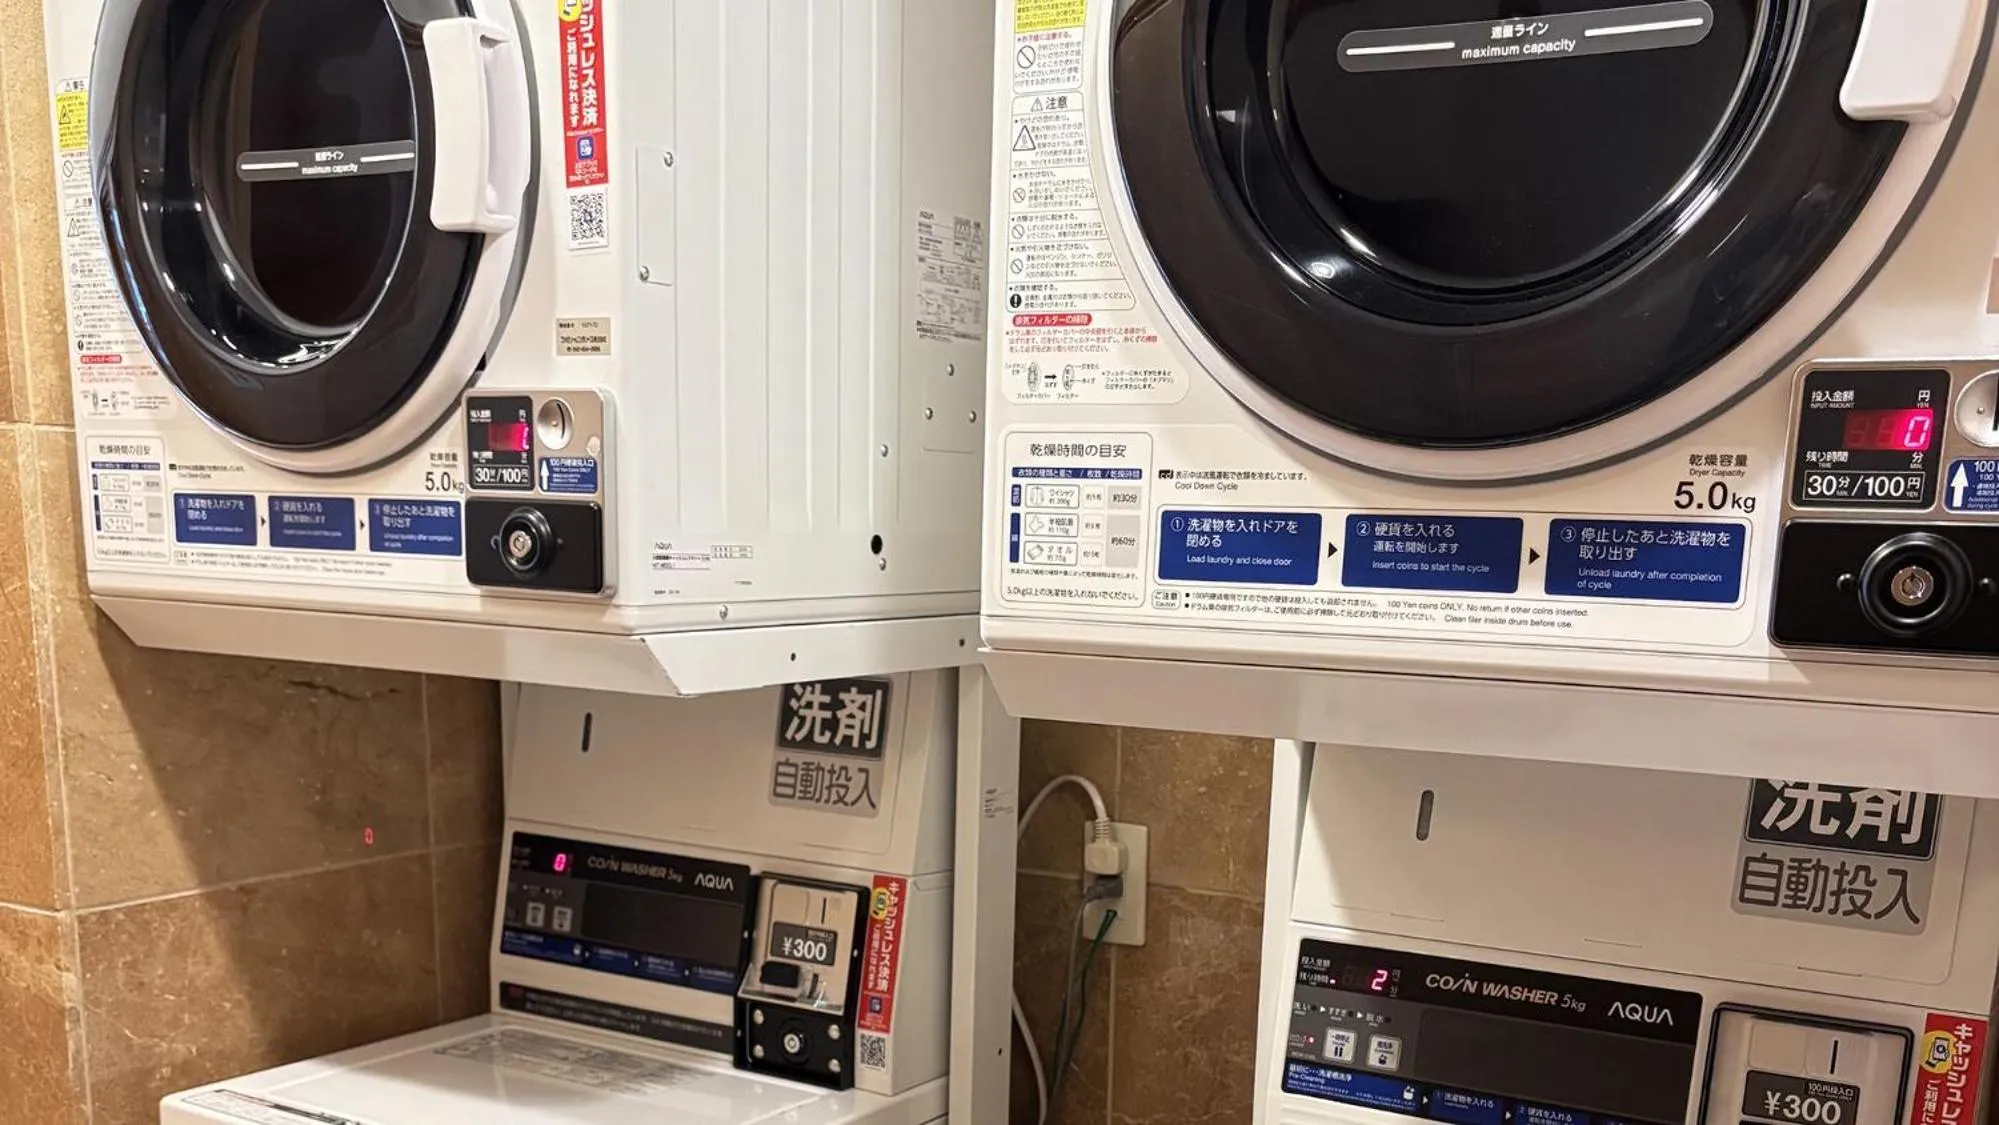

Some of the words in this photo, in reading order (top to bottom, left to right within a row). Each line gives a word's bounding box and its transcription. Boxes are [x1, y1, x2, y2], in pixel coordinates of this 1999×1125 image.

[1461, 44, 1520, 59] maximum
[1522, 38, 1576, 56] capacity
[1045, 96, 1068, 110] 注意
[1811, 390, 1854, 402] 投入金額
[1918, 390, 1931, 402] 円
[1904, 416, 1930, 447] 0
[1030, 443, 1127, 458] 乾燥時間の目安
[1805, 451, 1849, 463] 残り時間
[1912, 451, 1923, 463] 分
[1689, 454, 1748, 467] 乾燥容量
[1689, 468, 1709, 477] Dryer
[1711, 468, 1745, 478] Capacity
[1175, 482, 1193, 490] Cool
[1194, 482, 1215, 490] Down
[1217, 482, 1239, 492] Cycle
[1112, 493, 1137, 503] 約30分
[1187, 518, 1298, 534] 洗濯物を入れドアを
[1374, 522, 1455, 538] 硬貨を入れる
[1111, 536, 1136, 546] 約60分
[1186, 534, 1222, 548] 閉める
[1581, 527, 1731, 547] 停止したあと洗濯物を
[1373, 541, 1459, 554] 運転を開始します
[1578, 545, 1637, 561] 取り出す
[1187, 555, 1206, 563] Load
[1207, 555, 1234, 565] laundry
[1236, 556, 1250, 565] and
[1251, 557, 1272, 565] close
[1273, 557, 1292, 566] door
[1372, 561, 1395, 569] Insert
[1396, 562, 1418, 570] coins
[1420, 562, 1429, 571] to
[1431, 562, 1450, 571] start
[1451, 563, 1465, 572] the
[1466, 564, 1489, 575] cycle
[1578, 568, 1610, 578] Unload
[1612, 569, 1645, 580] laundry
[1647, 570, 1668, 579] after
[1670, 571, 1722, 583] completion
[1577, 580, 1587, 589] of
[1588, 580, 1612, 591] cycle
[1154, 592, 1178, 601] ご注意
[1403, 601, 1417, 609] Yen
[1418, 602, 1438, 610] coins
[1440, 602, 1464, 611] ONLY.
[1466, 604, 1478, 612] No
[1479, 605, 1501, 613] return
[1511, 606, 1530, 614] other
[1532, 607, 1554, 615] coins
[1556, 607, 1588, 617] inserted.
[1444, 614, 1467, 623] Clean
[1483, 616, 1506, 625] inside
[1507, 618, 1528, 626] drum
[1529, 618, 1555, 628] before
[1557, 621, 1572, 629] use.
[784, 682, 883, 749] 洗剤
[773, 758, 877, 810] 自動投入
[1760, 778, 1927, 844] 洗剤
[694, 873, 734, 892] AQUA
[1738, 852, 1920, 925] 自動投入
[783, 936, 828, 961] ¥300
[1371, 969, 1388, 991] 2
[1482, 980, 1559, 1005] WASHER
[1560, 994, 1587, 1012] 5kg
[1608, 1001, 1674, 1026] AQUA
[1941, 1023, 1974, 1125] キャッシュレ
[1764, 1090, 1842, 1124] ¥300
